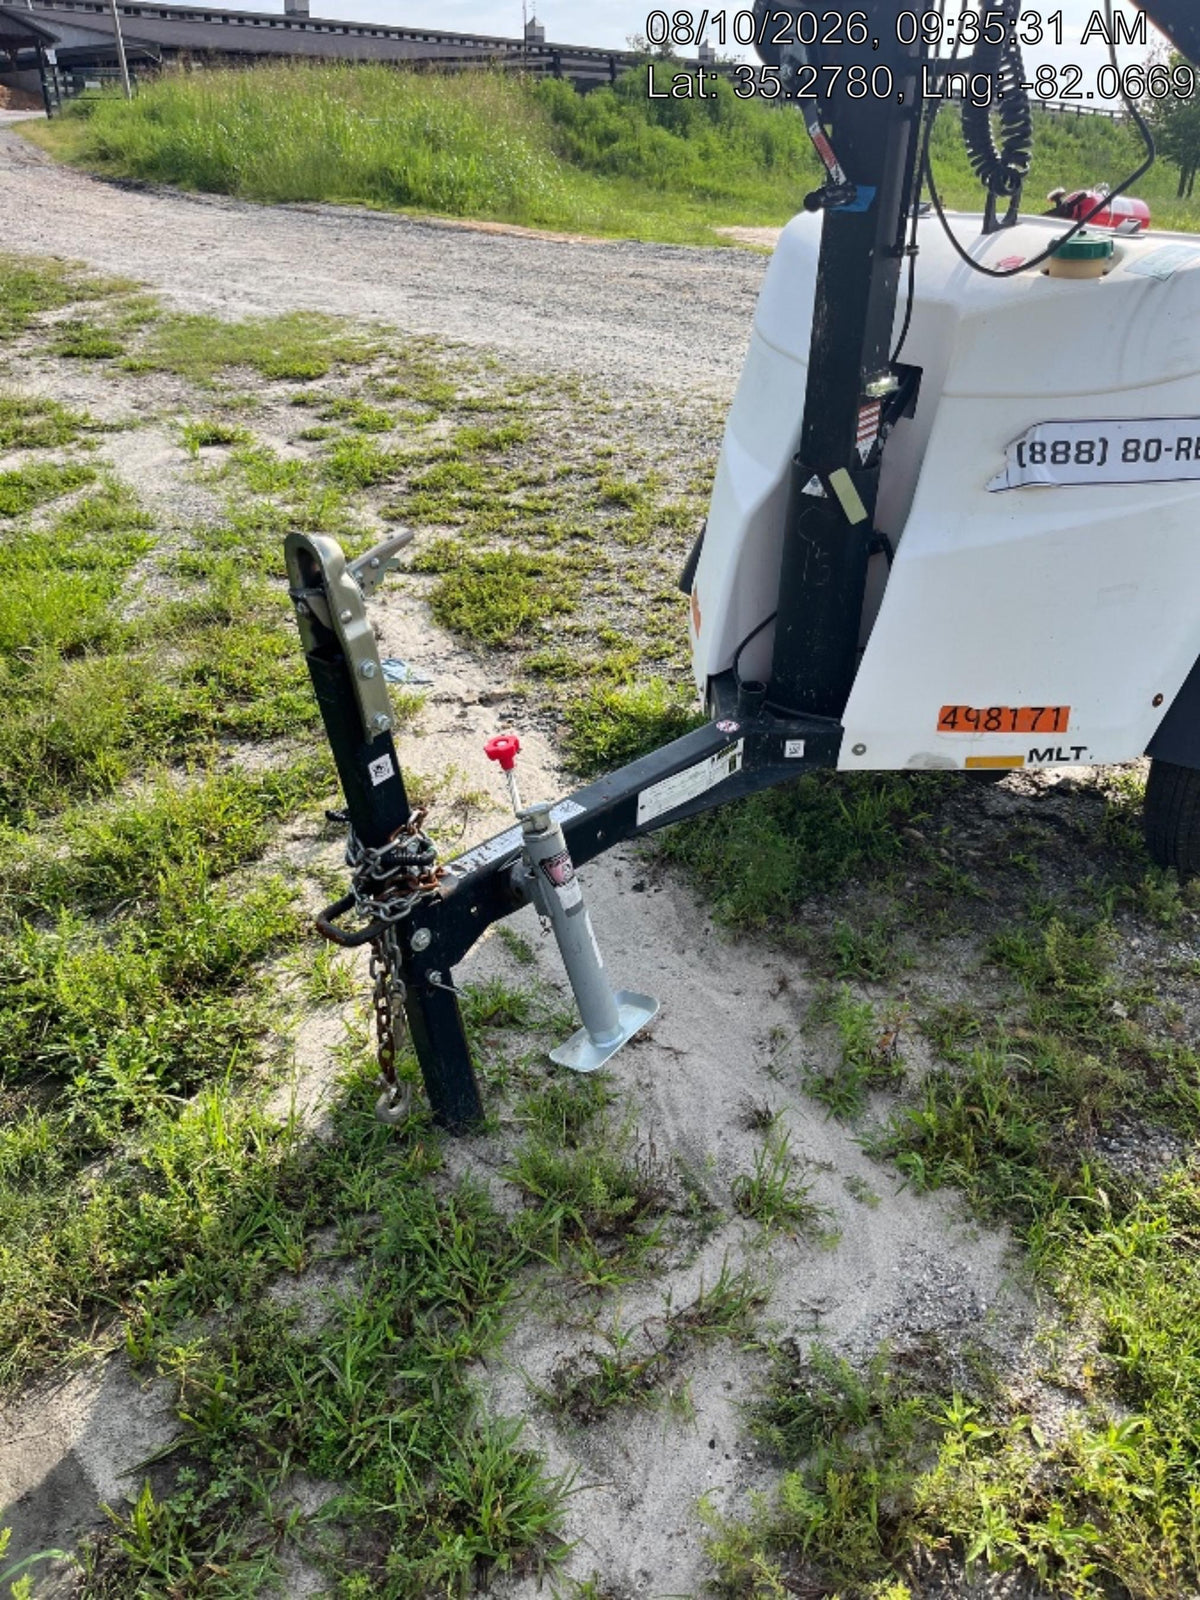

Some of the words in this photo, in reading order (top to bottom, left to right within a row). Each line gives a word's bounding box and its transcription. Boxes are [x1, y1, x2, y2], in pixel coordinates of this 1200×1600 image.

[1016, 437, 1109, 468] (888)
[941, 706, 1061, 732] 498171
[1028, 746, 1088, 763] MLT
